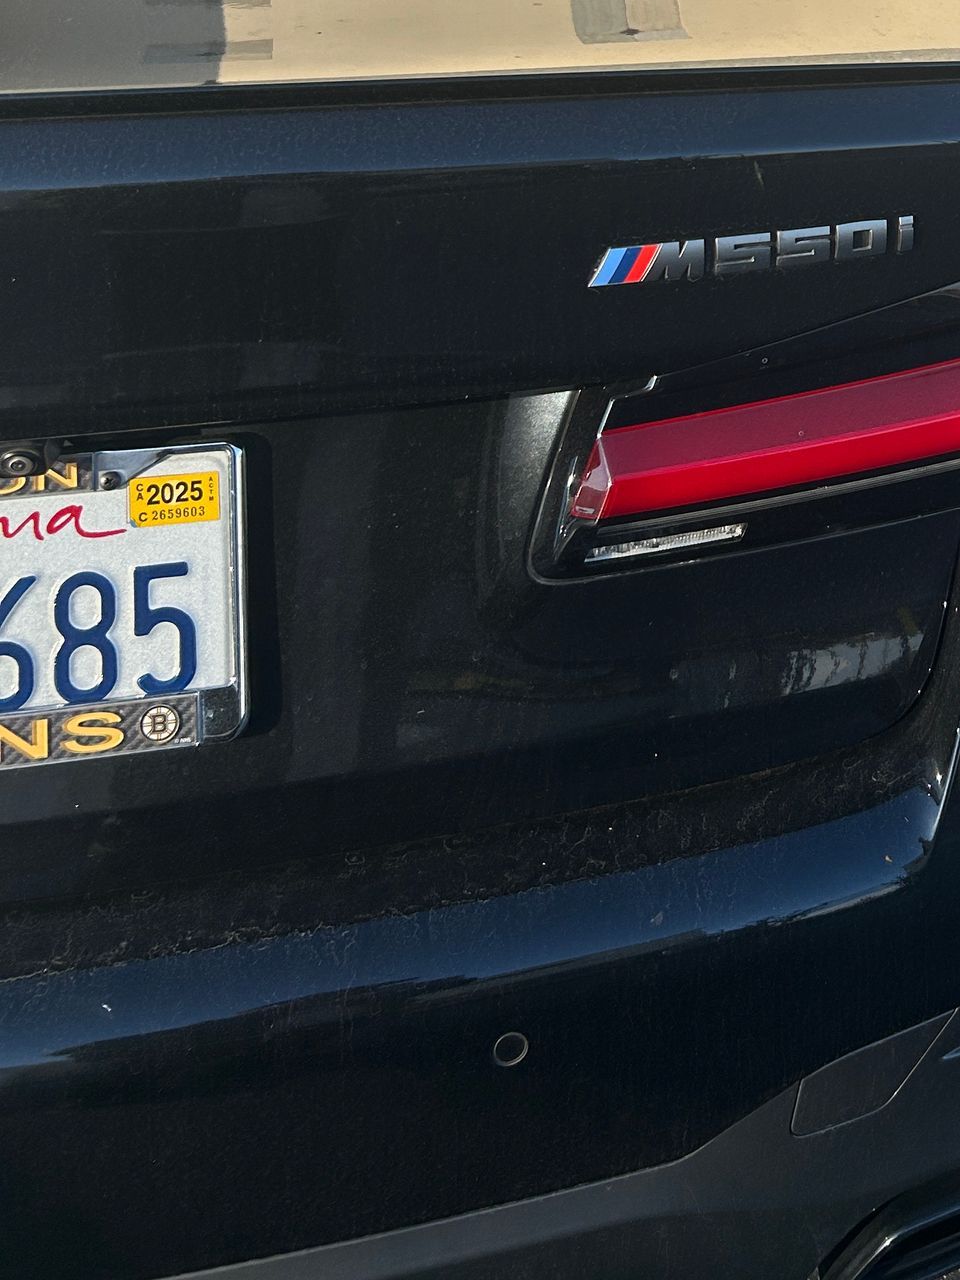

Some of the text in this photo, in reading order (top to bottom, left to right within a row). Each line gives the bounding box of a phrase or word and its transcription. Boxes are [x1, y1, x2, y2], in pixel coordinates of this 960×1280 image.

[641, 215, 915, 283] M550i
[146, 480, 204, 506] 2025
[138, 506, 206, 522] C 2659603
[151, 714, 167, 733] B
